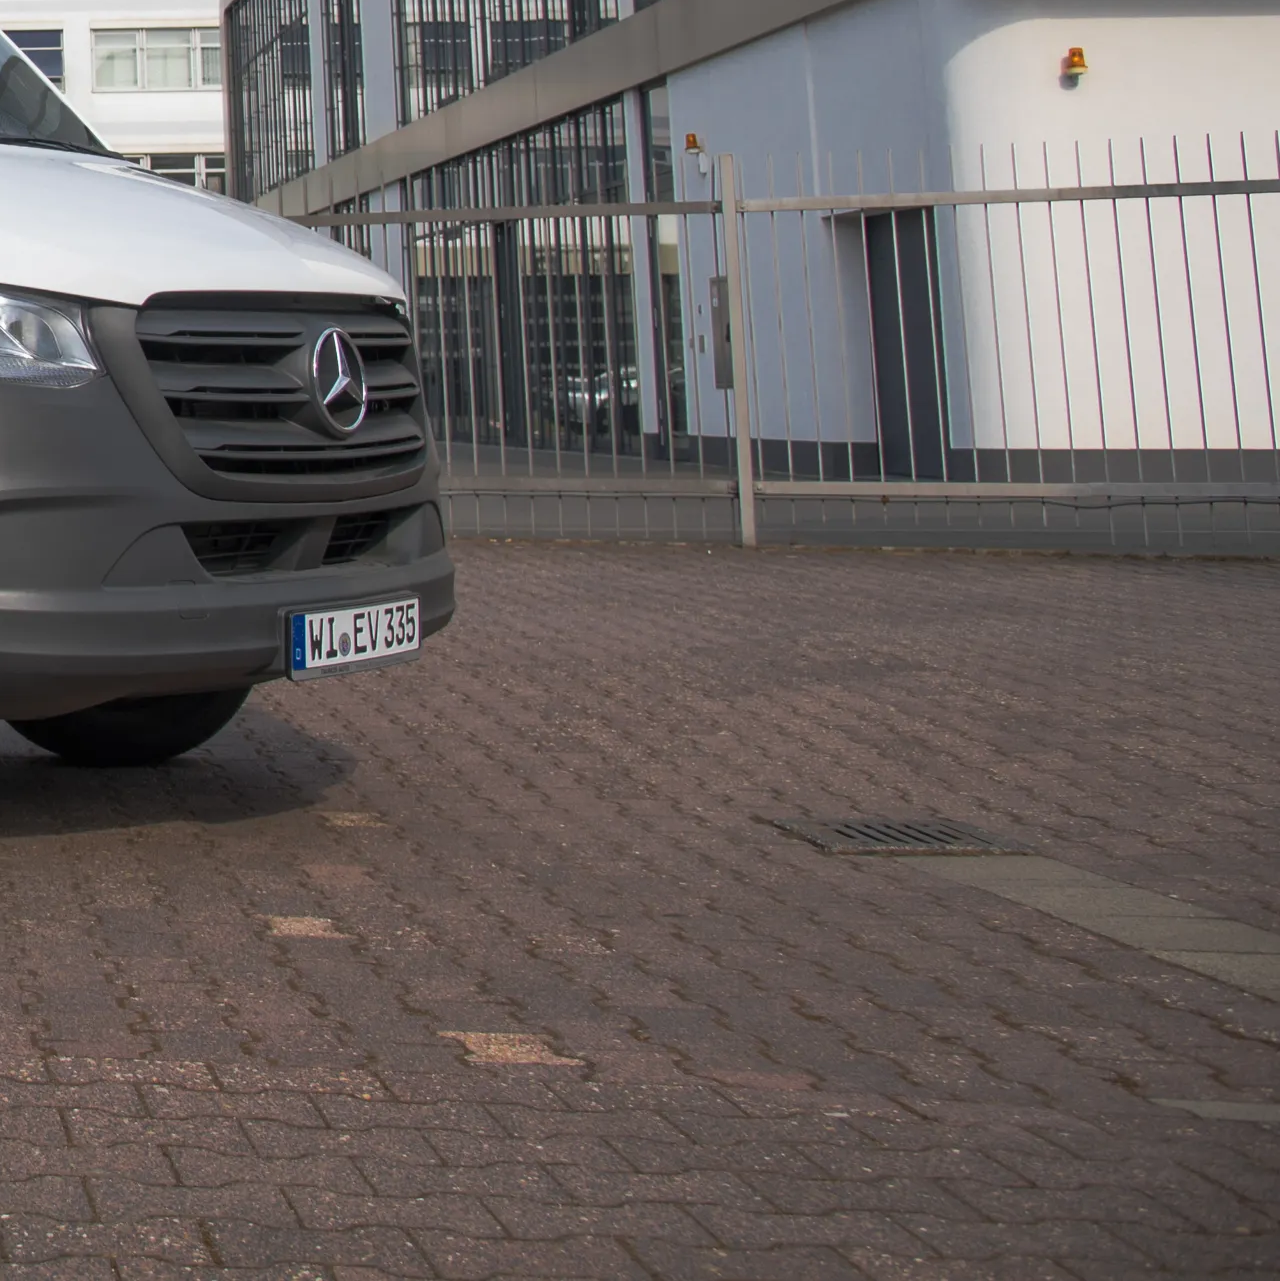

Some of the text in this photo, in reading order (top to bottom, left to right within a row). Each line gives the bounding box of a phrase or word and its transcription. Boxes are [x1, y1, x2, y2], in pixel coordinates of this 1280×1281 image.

[309, 617, 338, 661] WI
[353, 609, 379, 654] EV
[384, 603, 416, 648] 335
